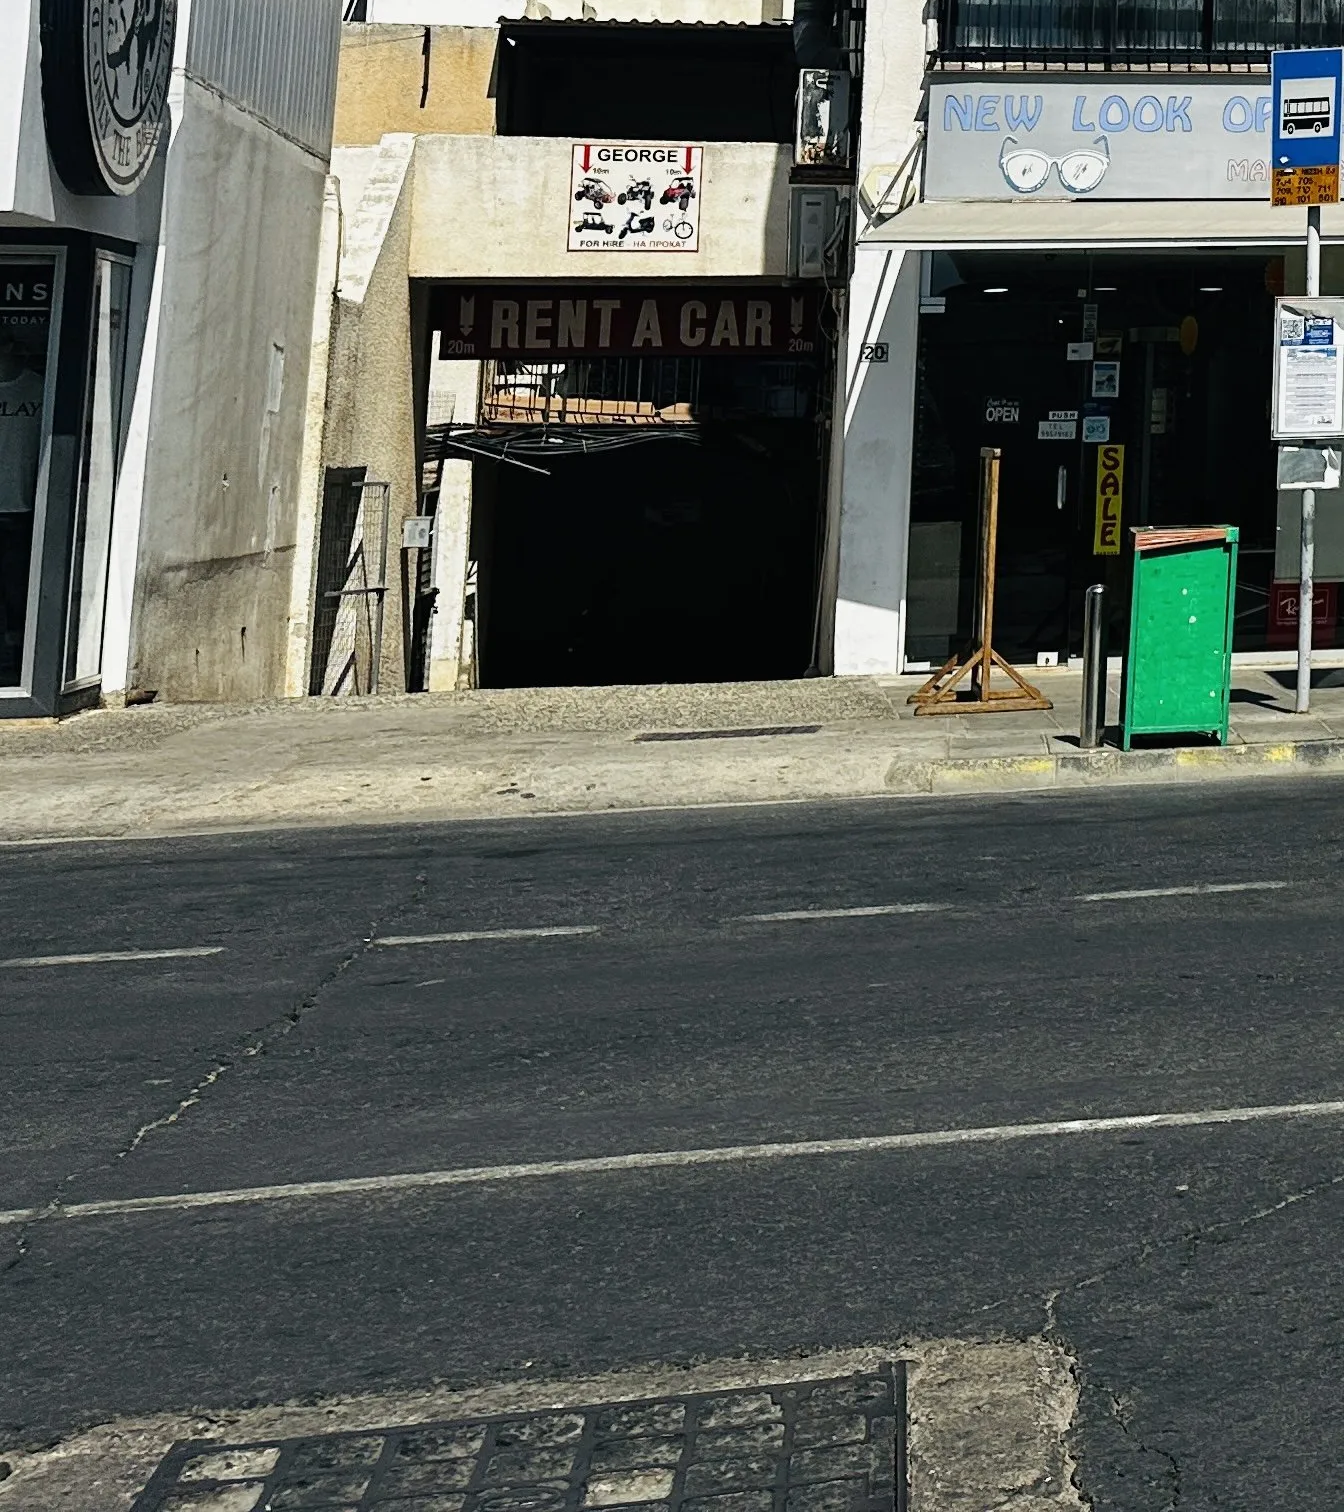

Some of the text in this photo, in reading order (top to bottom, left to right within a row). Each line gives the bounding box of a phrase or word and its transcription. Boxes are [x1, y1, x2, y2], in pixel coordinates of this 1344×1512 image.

[943, 94, 1044, 132] NEW
[1071, 94, 1193, 133] LOOK
[597, 148, 678, 163] GEORGE
[579, 240, 625, 248] FOR HIRE
[2, 316, 46, 325] TODAY
[490, 299, 773, 349] RENT A CAR
[447, 340, 475, 355] 20m
[864, 345, 885, 360] 20
[985, 407, 1020, 422] OPEN
[1100, 446, 1120, 547] SALE
